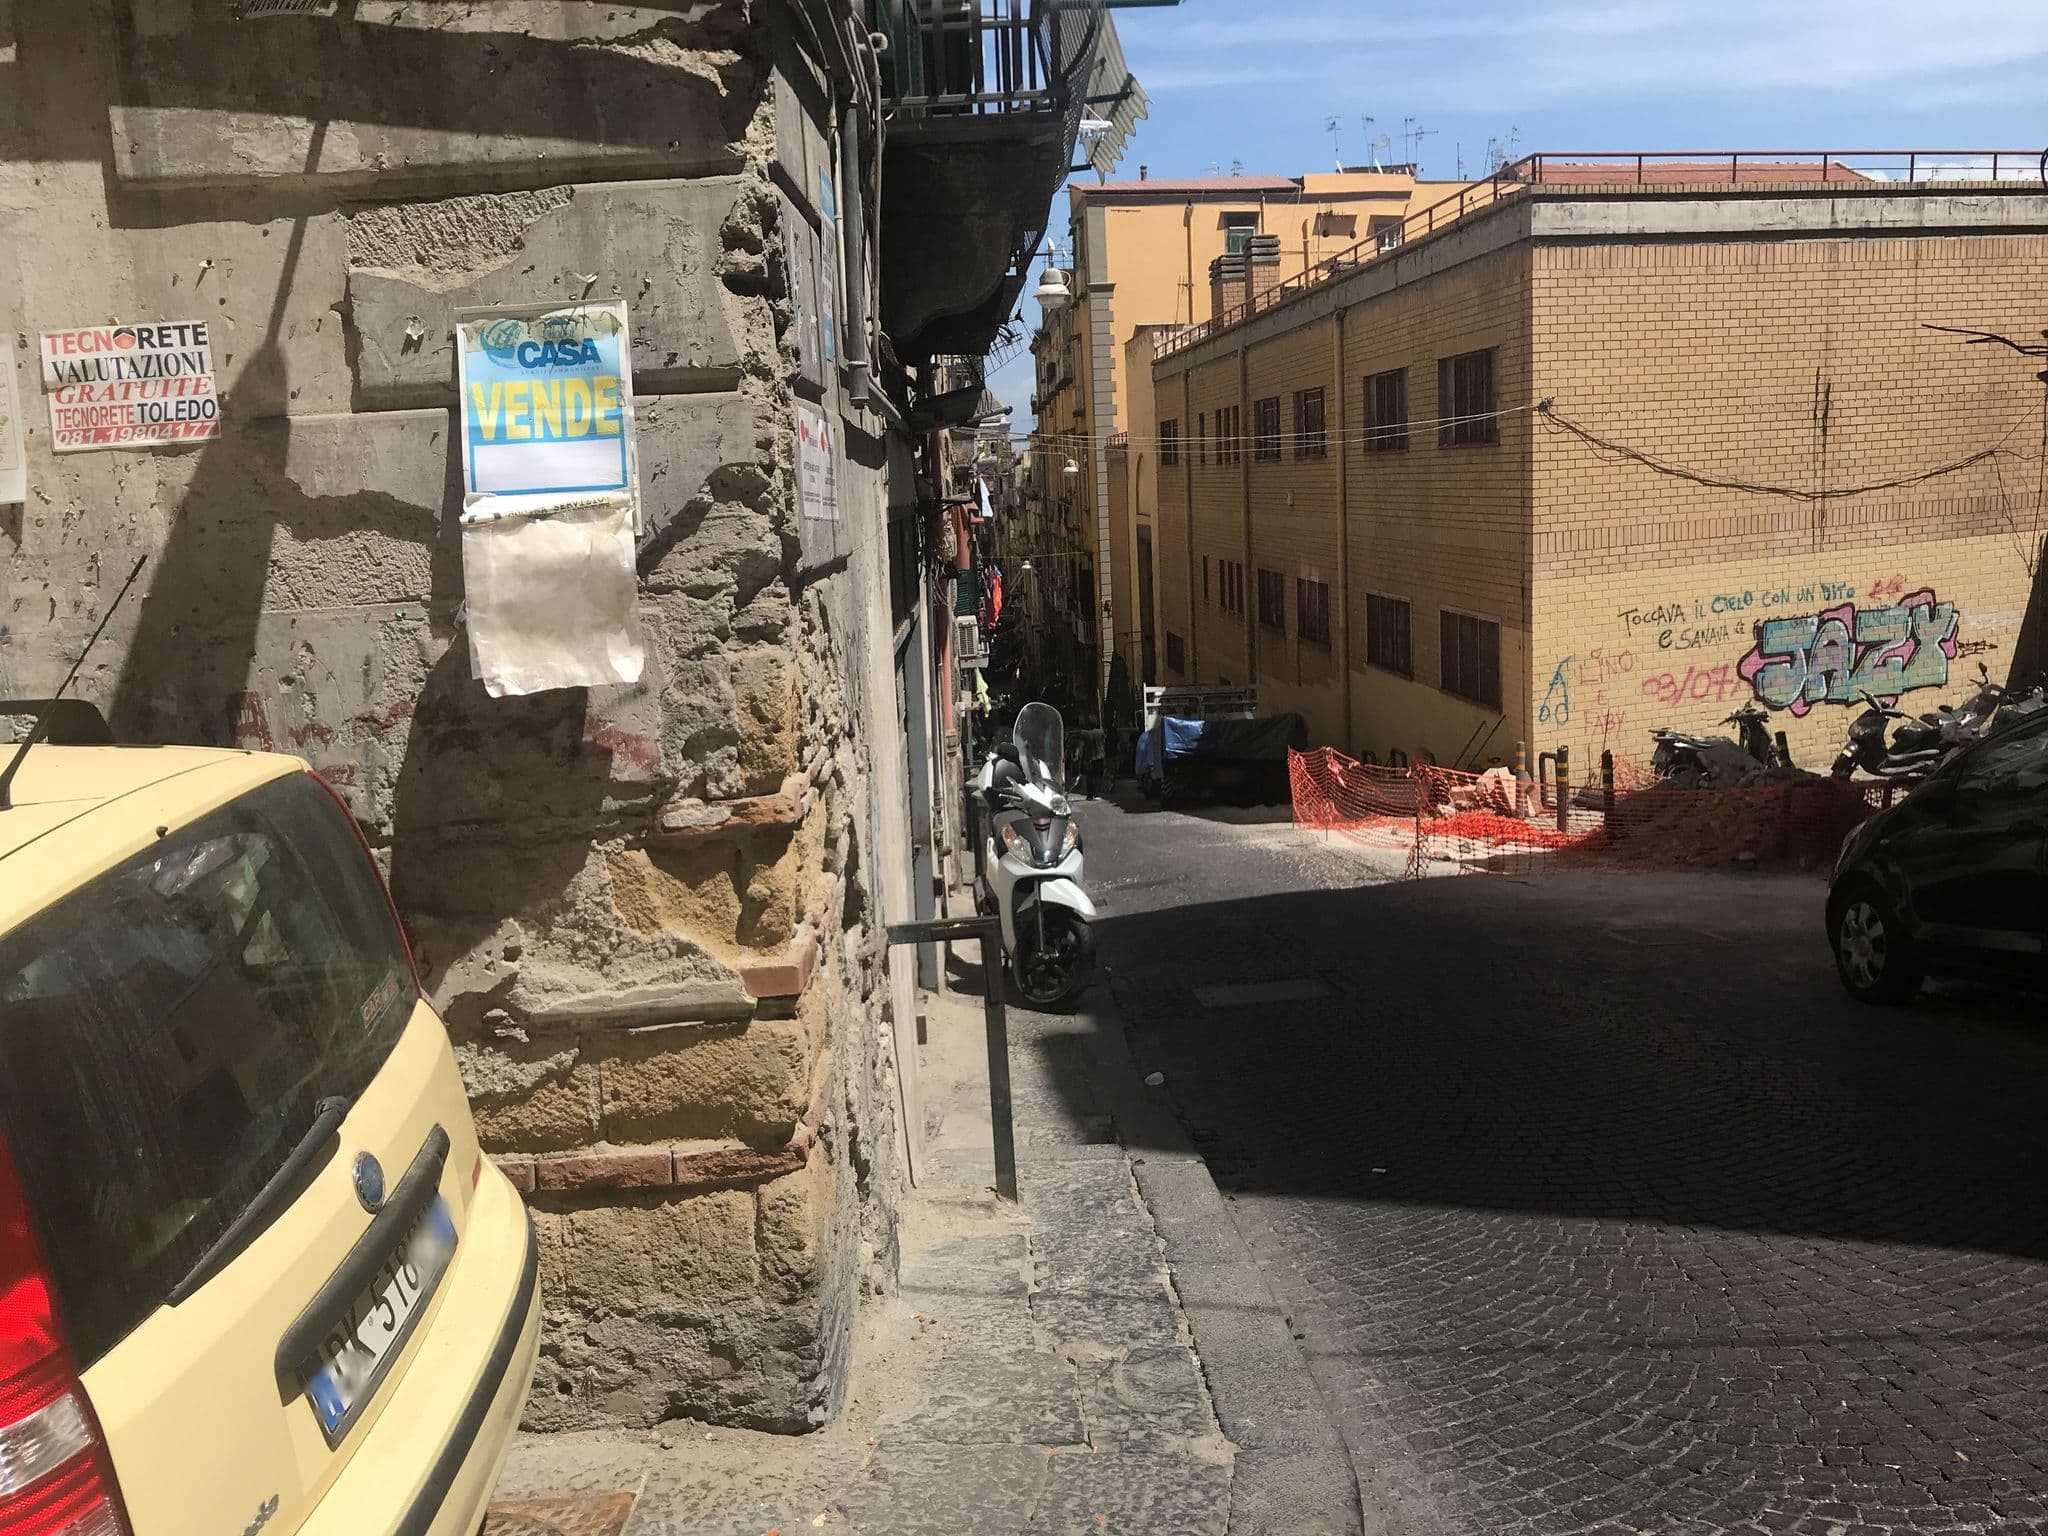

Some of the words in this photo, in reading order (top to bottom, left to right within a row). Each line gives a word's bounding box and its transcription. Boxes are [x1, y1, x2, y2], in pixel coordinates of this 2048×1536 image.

[45, 324, 208, 356] TECNORETE
[518, 338, 602, 369] CASA
[52, 351, 206, 383] VALUTAZIONI
[55, 376, 212, 404] GRATUITE
[55, 404, 135, 429] TECNORETE
[137, 399, 216, 423] TOLEDO
[471, 376, 620, 441] VENDE
[57, 421, 217, 446] 081.19804177
[1617, 603, 1686, 636] TOCCAVA
